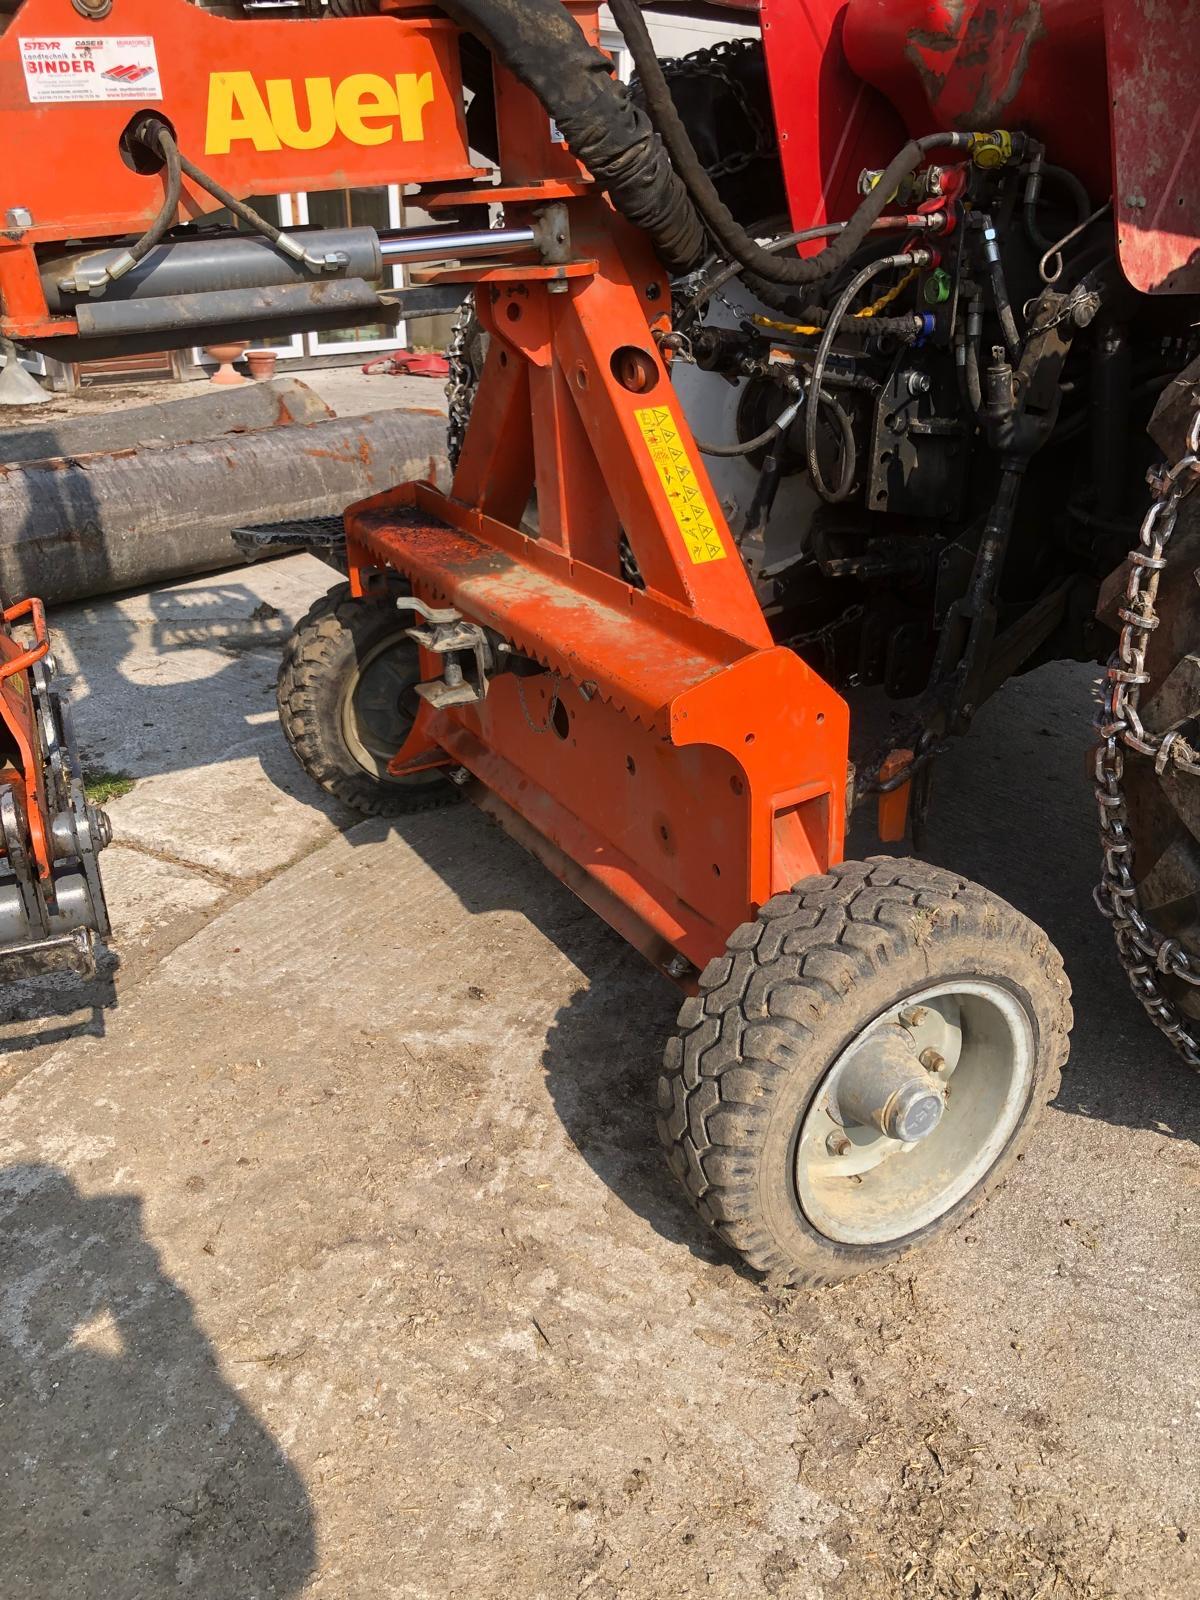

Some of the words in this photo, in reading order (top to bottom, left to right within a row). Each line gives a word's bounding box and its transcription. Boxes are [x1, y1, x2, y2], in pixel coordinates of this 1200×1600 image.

[23, 41, 61, 51] STEYR
[23, 52, 69, 60] Landtechnik
[26, 60, 96, 74] BINDER
[205, 71, 434, 155] Auer
